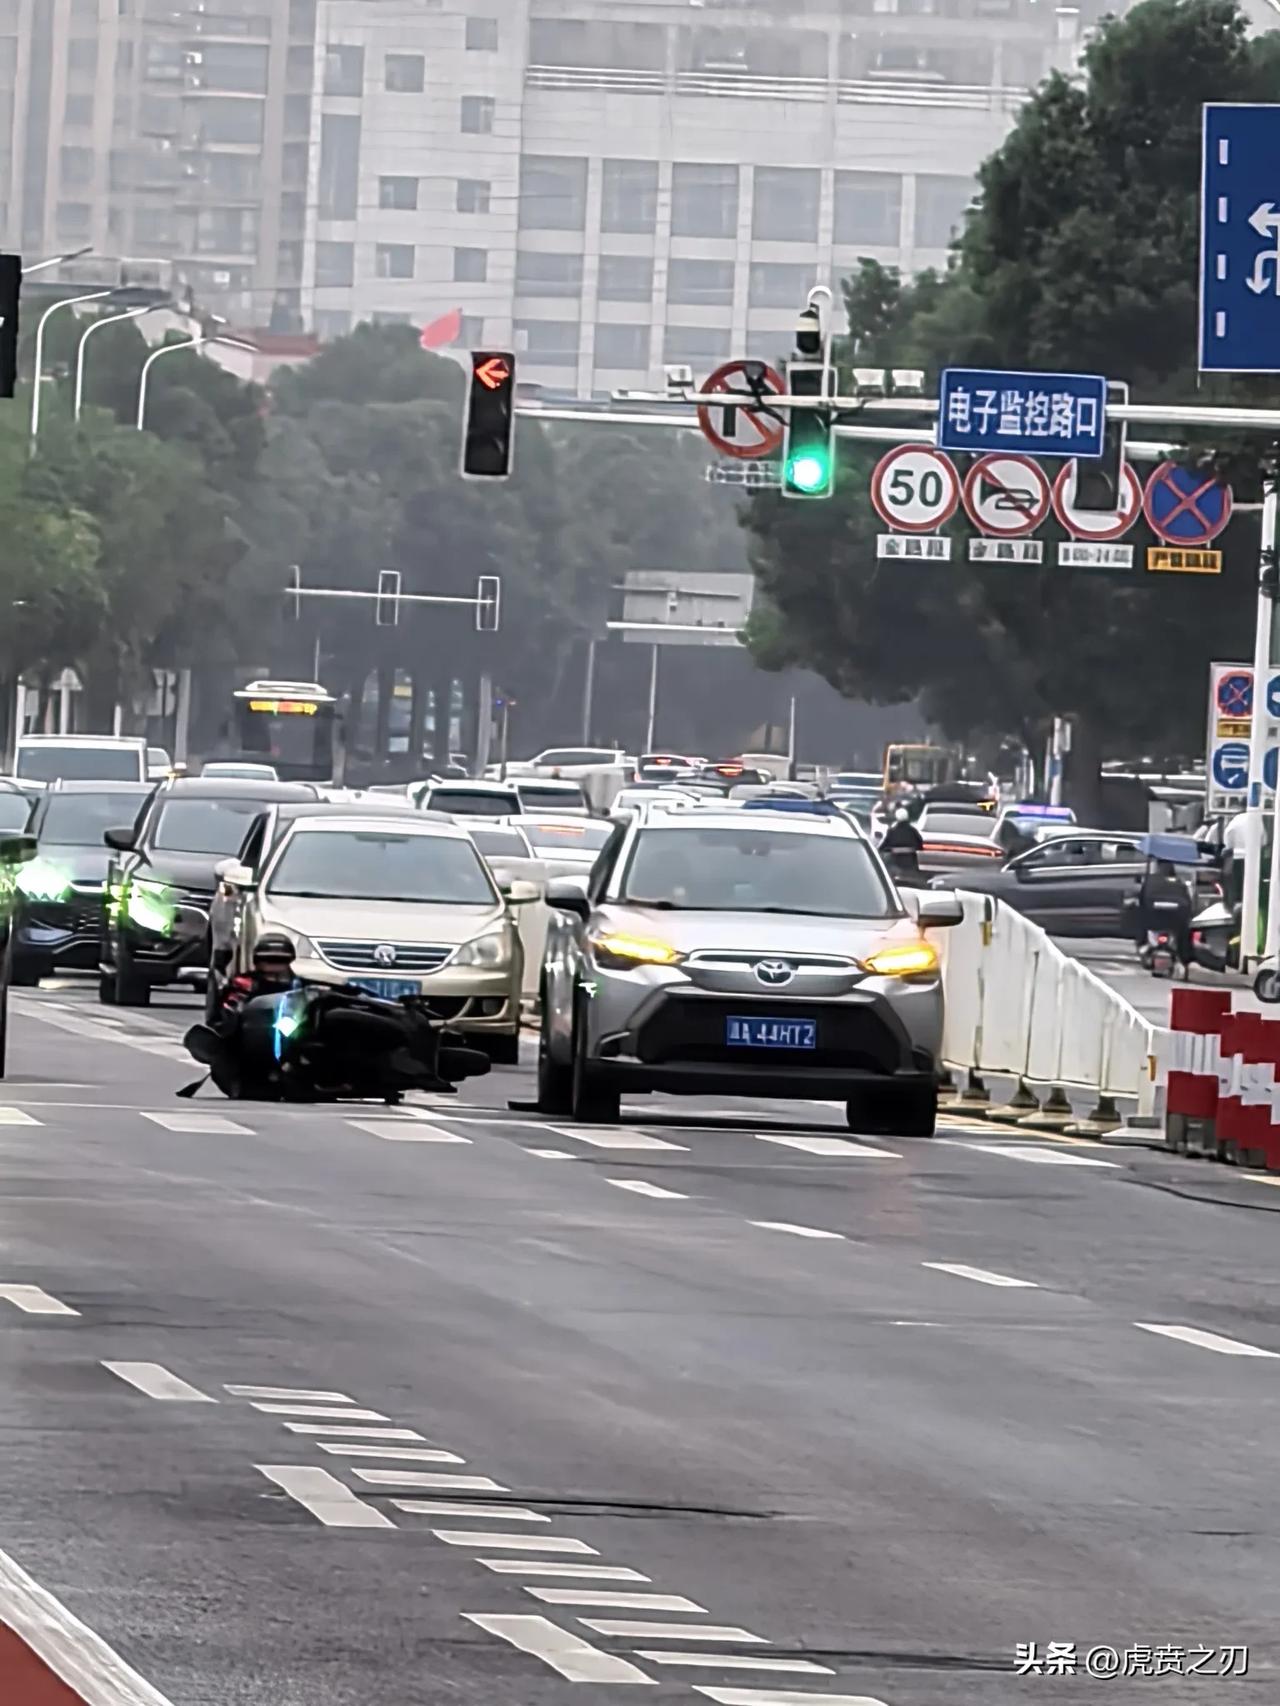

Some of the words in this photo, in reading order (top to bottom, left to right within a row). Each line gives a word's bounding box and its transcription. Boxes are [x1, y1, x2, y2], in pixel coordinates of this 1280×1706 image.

[949, 386, 1097, 439] 电子监控路口
[888, 469, 943, 507] 50
